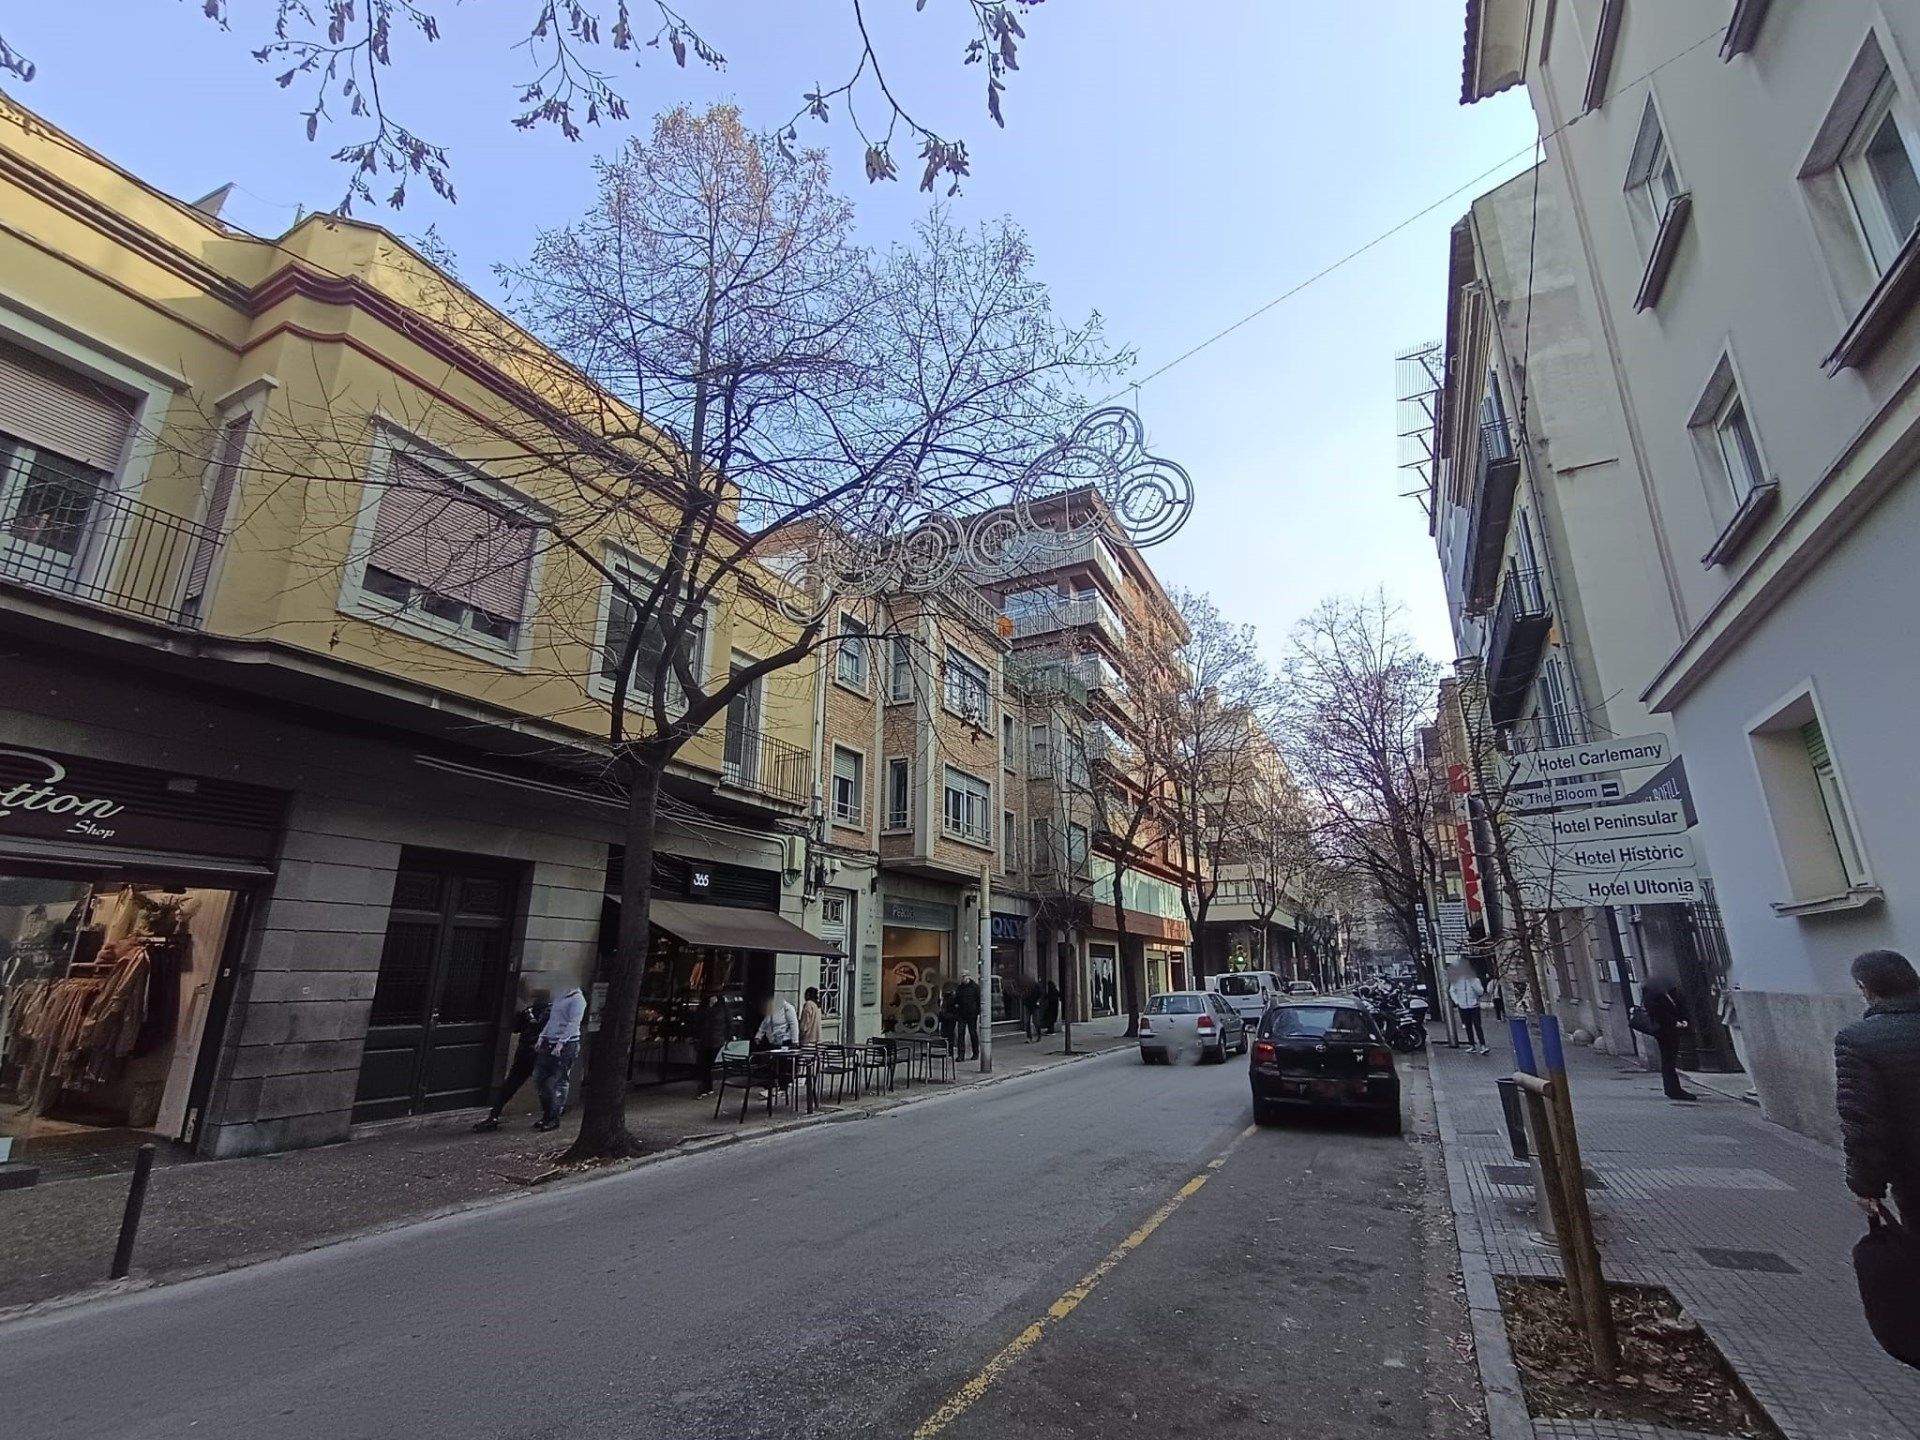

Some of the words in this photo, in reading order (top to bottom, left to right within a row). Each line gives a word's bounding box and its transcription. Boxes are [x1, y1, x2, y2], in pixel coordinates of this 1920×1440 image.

[1538, 754, 1575, 773] Hotel
[1578, 742, 1662, 766] Carlemany
[1528, 793, 1551, 804] The
[1555, 788, 1598, 802] Bloom
[65, 820, 115, 839] Shop
[1551, 822, 1591, 835] Hotel
[1594, 810, 1679, 832] Peninsular
[1575, 849, 1616, 866] Hotel
[693, 873, 710, 887] 365
[1588, 880, 1630, 898] Hotel
[1634, 878, 1694, 896] Ultonia
